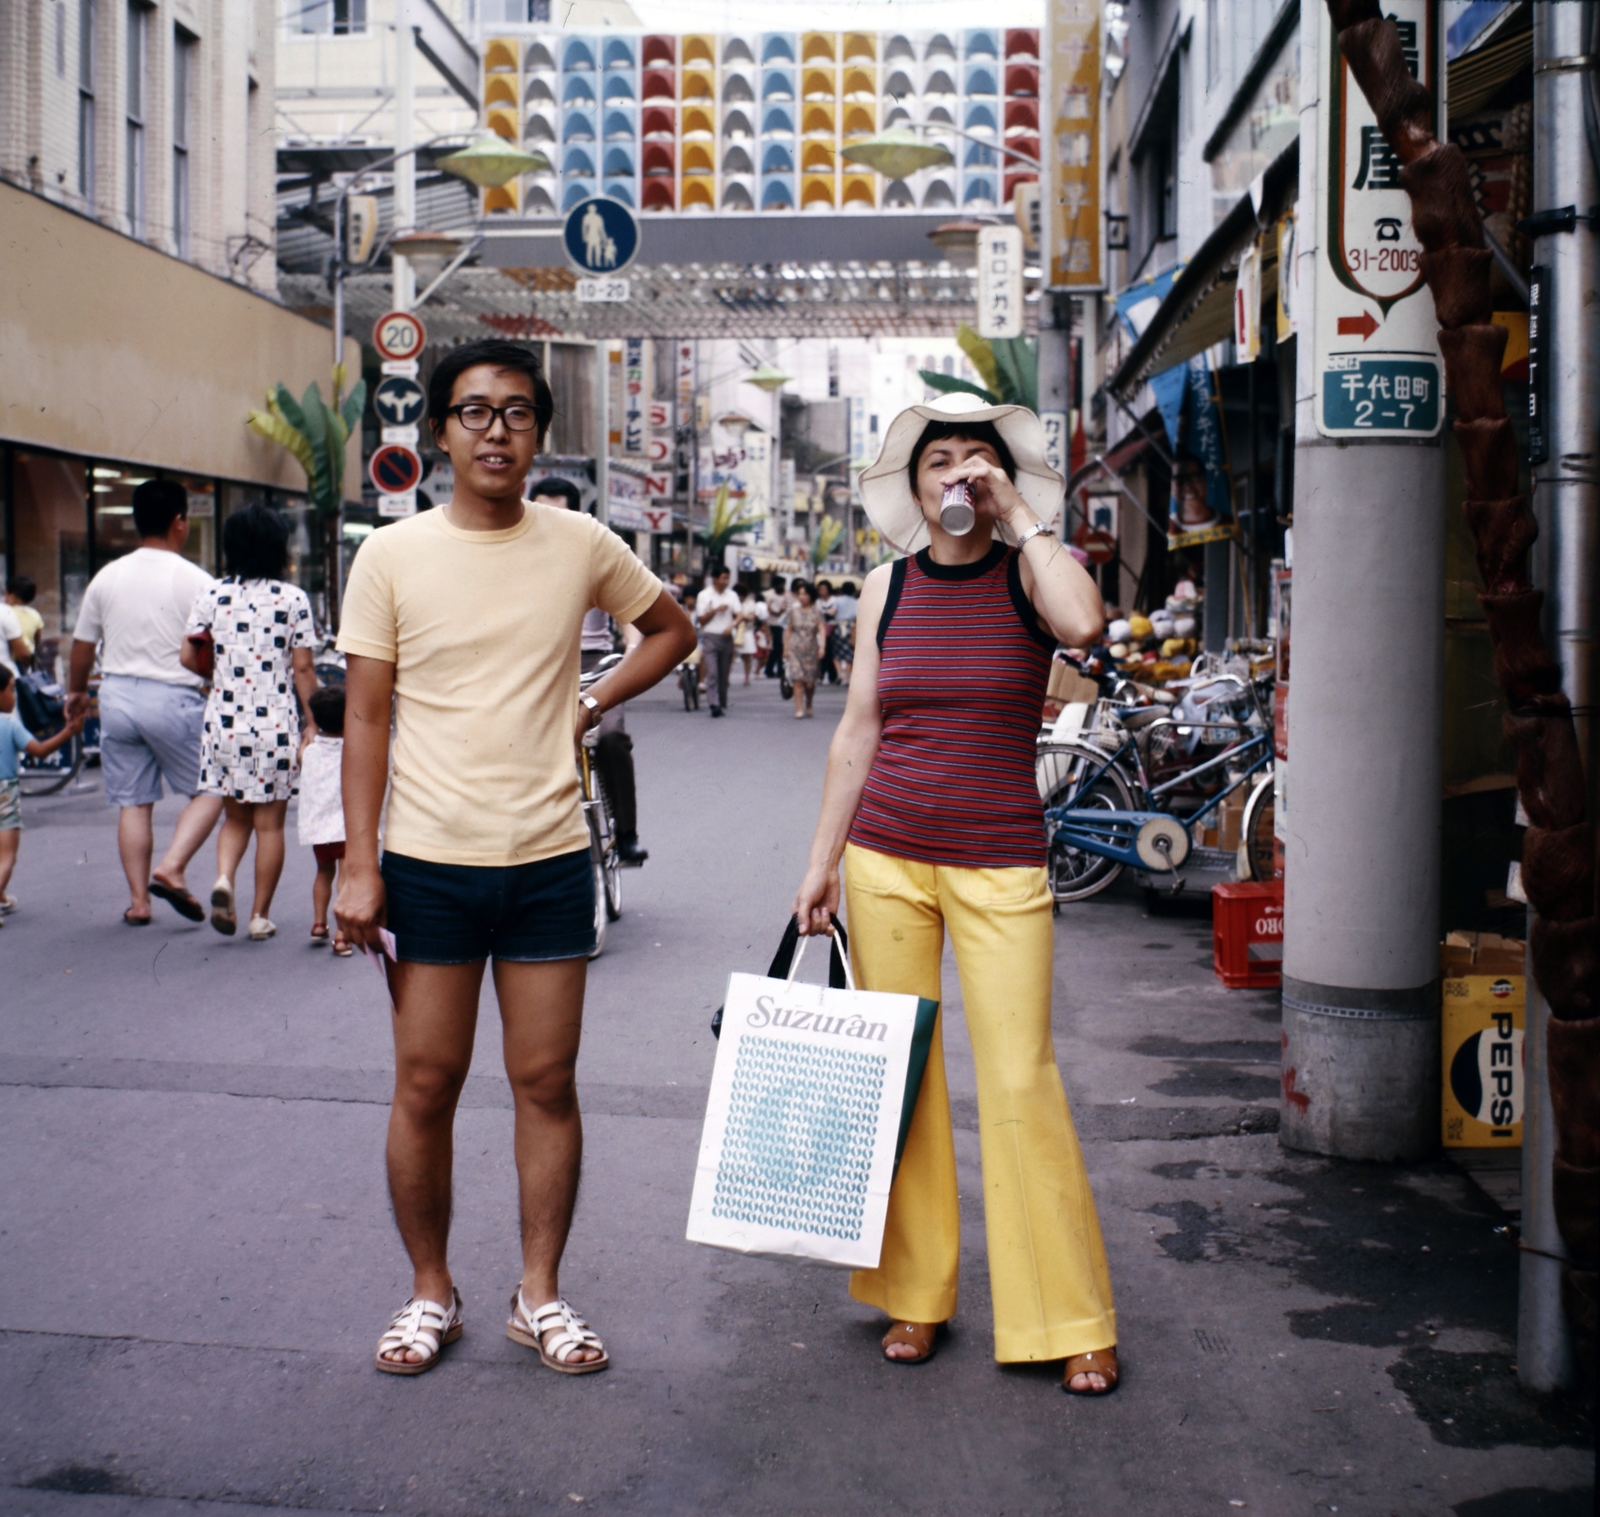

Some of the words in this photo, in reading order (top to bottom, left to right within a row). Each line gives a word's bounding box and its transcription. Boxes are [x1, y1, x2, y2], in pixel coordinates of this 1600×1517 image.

[1349, 248, 1420, 271] 31-2003
[386, 325, 414, 348] 20
[1328, 357, 1358, 370] ここは
[1341, 374, 1429, 403] 千代田町
[1354, 400, 1415, 428] 2-7
[645, 405, 667, 530] SONY
[746, 995, 889, 1042] Suzuran
[1491, 1012, 1514, 1137] PEPSI
